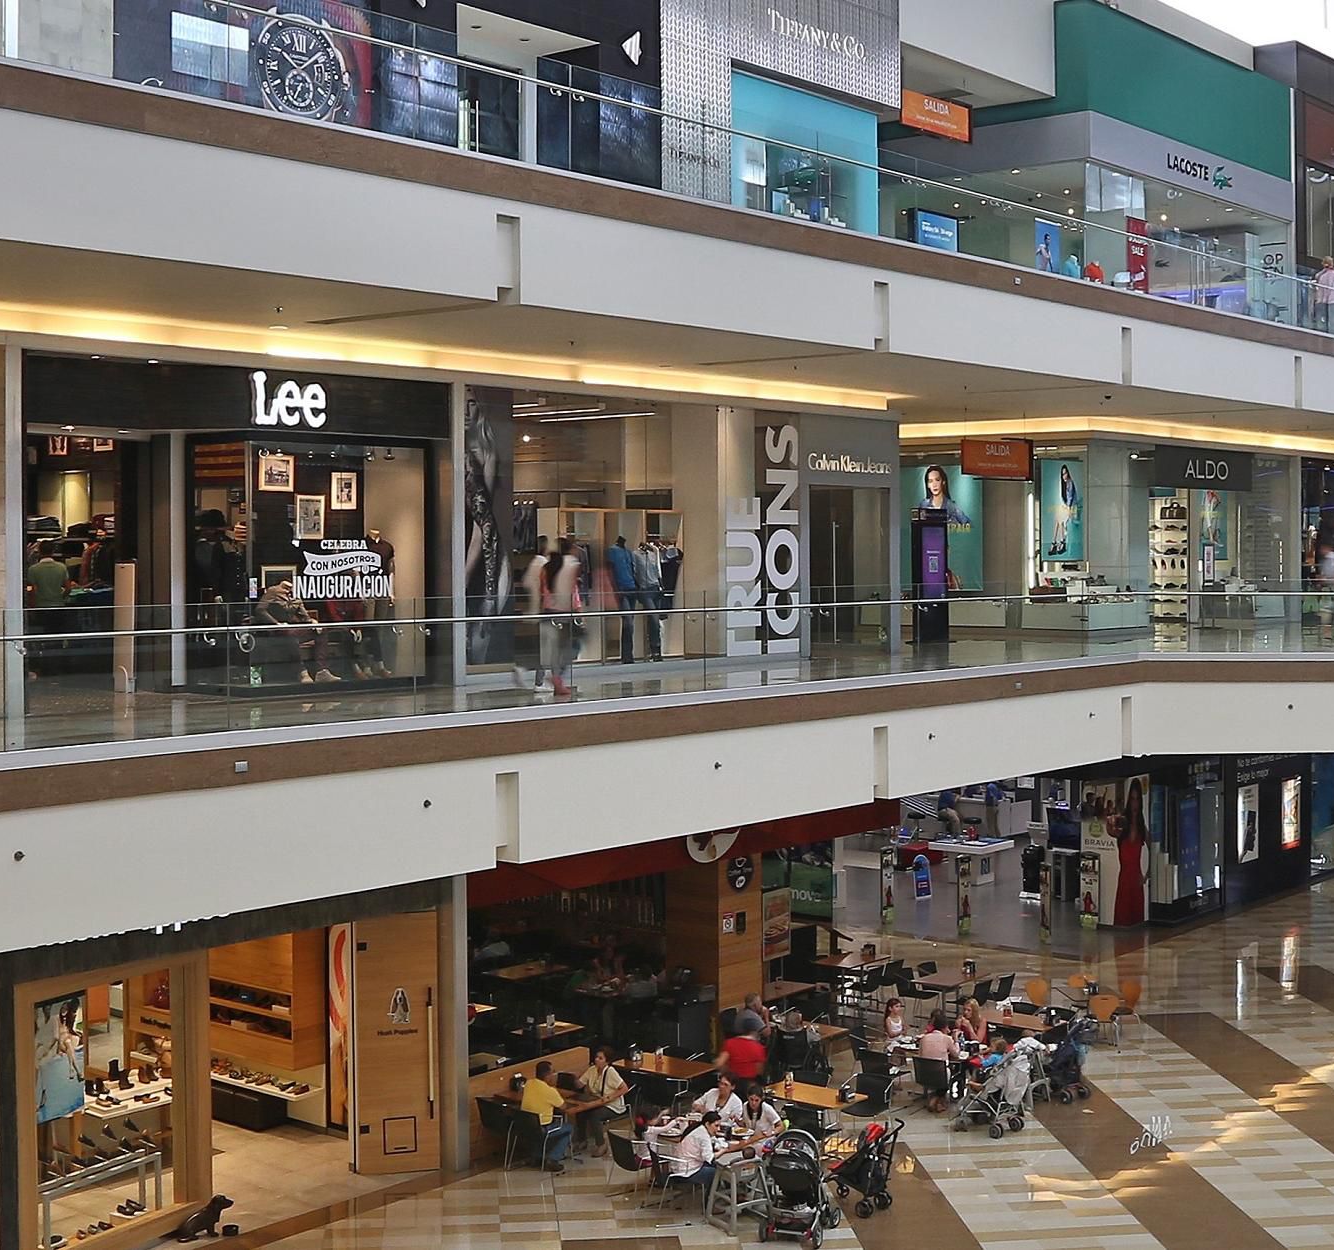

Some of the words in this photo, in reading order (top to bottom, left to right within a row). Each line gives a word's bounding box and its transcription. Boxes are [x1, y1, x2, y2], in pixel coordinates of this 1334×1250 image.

[923, 98, 950, 116] SALIDA
[1167, 152, 1210, 182] LACOSTE
[252, 370, 327, 429] Lee
[985, 443, 1011, 456] SALIDA
[808, 452, 840, 471] Calvin
[840, 454, 864, 473] Klein
[863, 456, 892, 474] Jeans
[1184, 458, 1229, 480] ALDO
[320, 539, 368, 551] CELEBRA
[764, 424, 800, 655] ICONS
[310, 560, 329, 571] CON
[331, 555, 376, 571] NOSOTROS
[292, 570, 394, 600] INAUGURACIÓN
[725, 497, 763, 657] TRUE
[1084, 838, 1116, 848] BRAVIA
